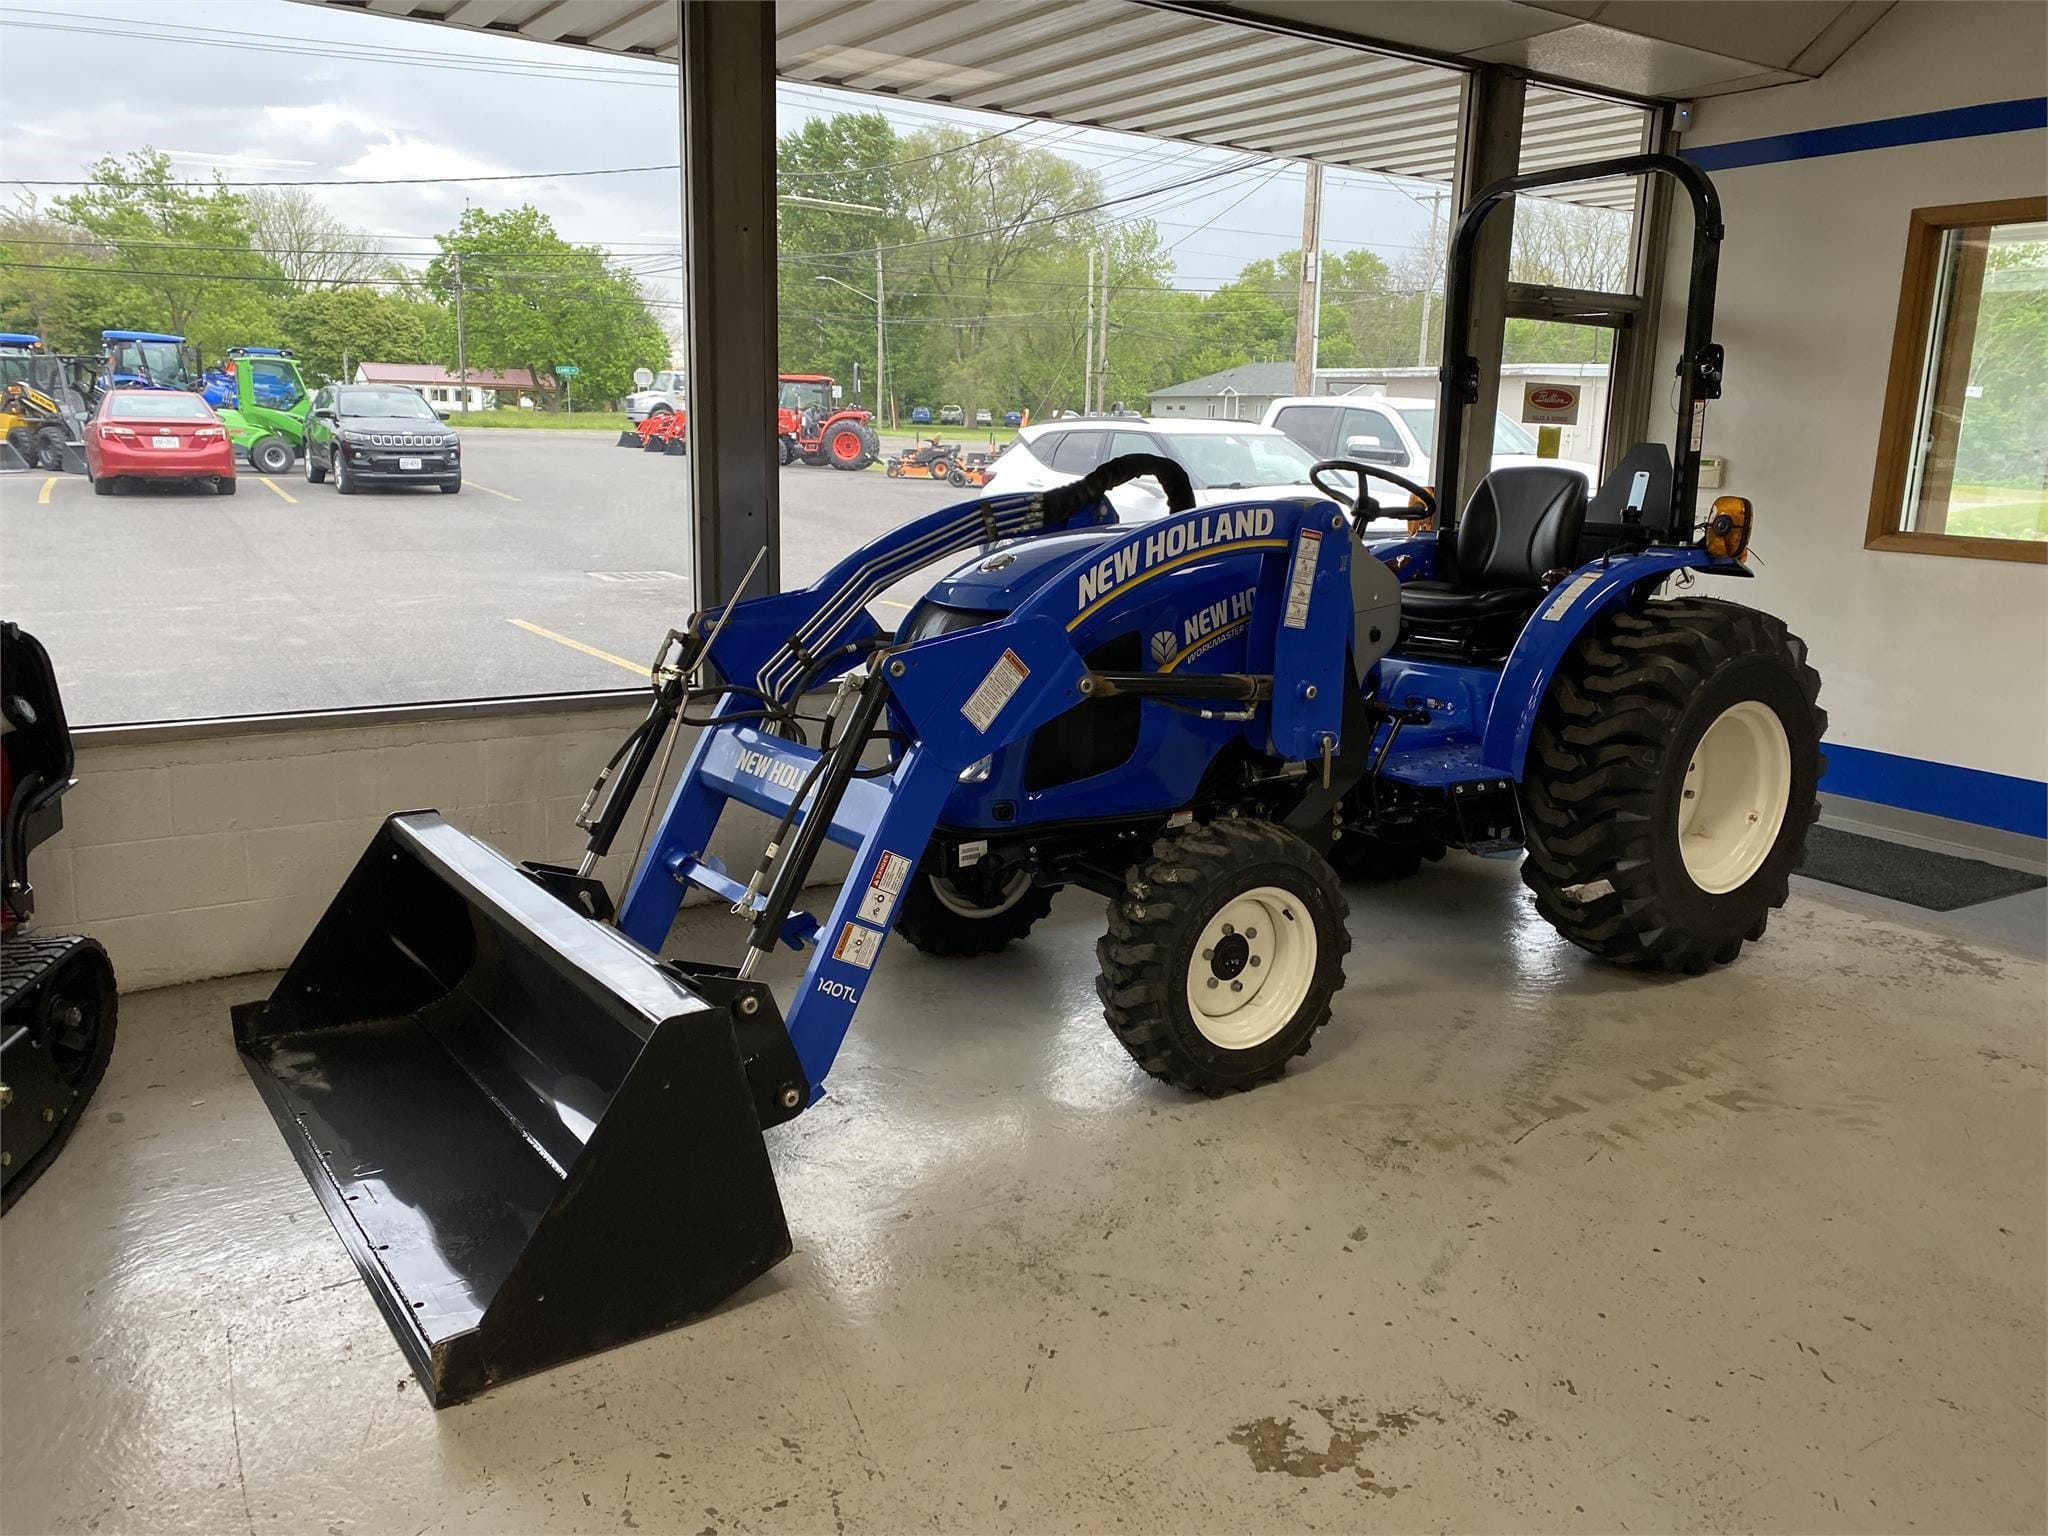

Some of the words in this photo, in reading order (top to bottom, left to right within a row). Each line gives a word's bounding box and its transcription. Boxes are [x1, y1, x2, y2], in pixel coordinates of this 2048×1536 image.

[1078, 540, 1140, 611] NEW
[1145, 508, 1275, 568] HOLLAND
[1184, 598, 1228, 645] NEW
[1187, 624, 1245, 664] WORKMASTER
[735, 749, 773, 779] NEW
[817, 976, 858, 1004] 140TL
